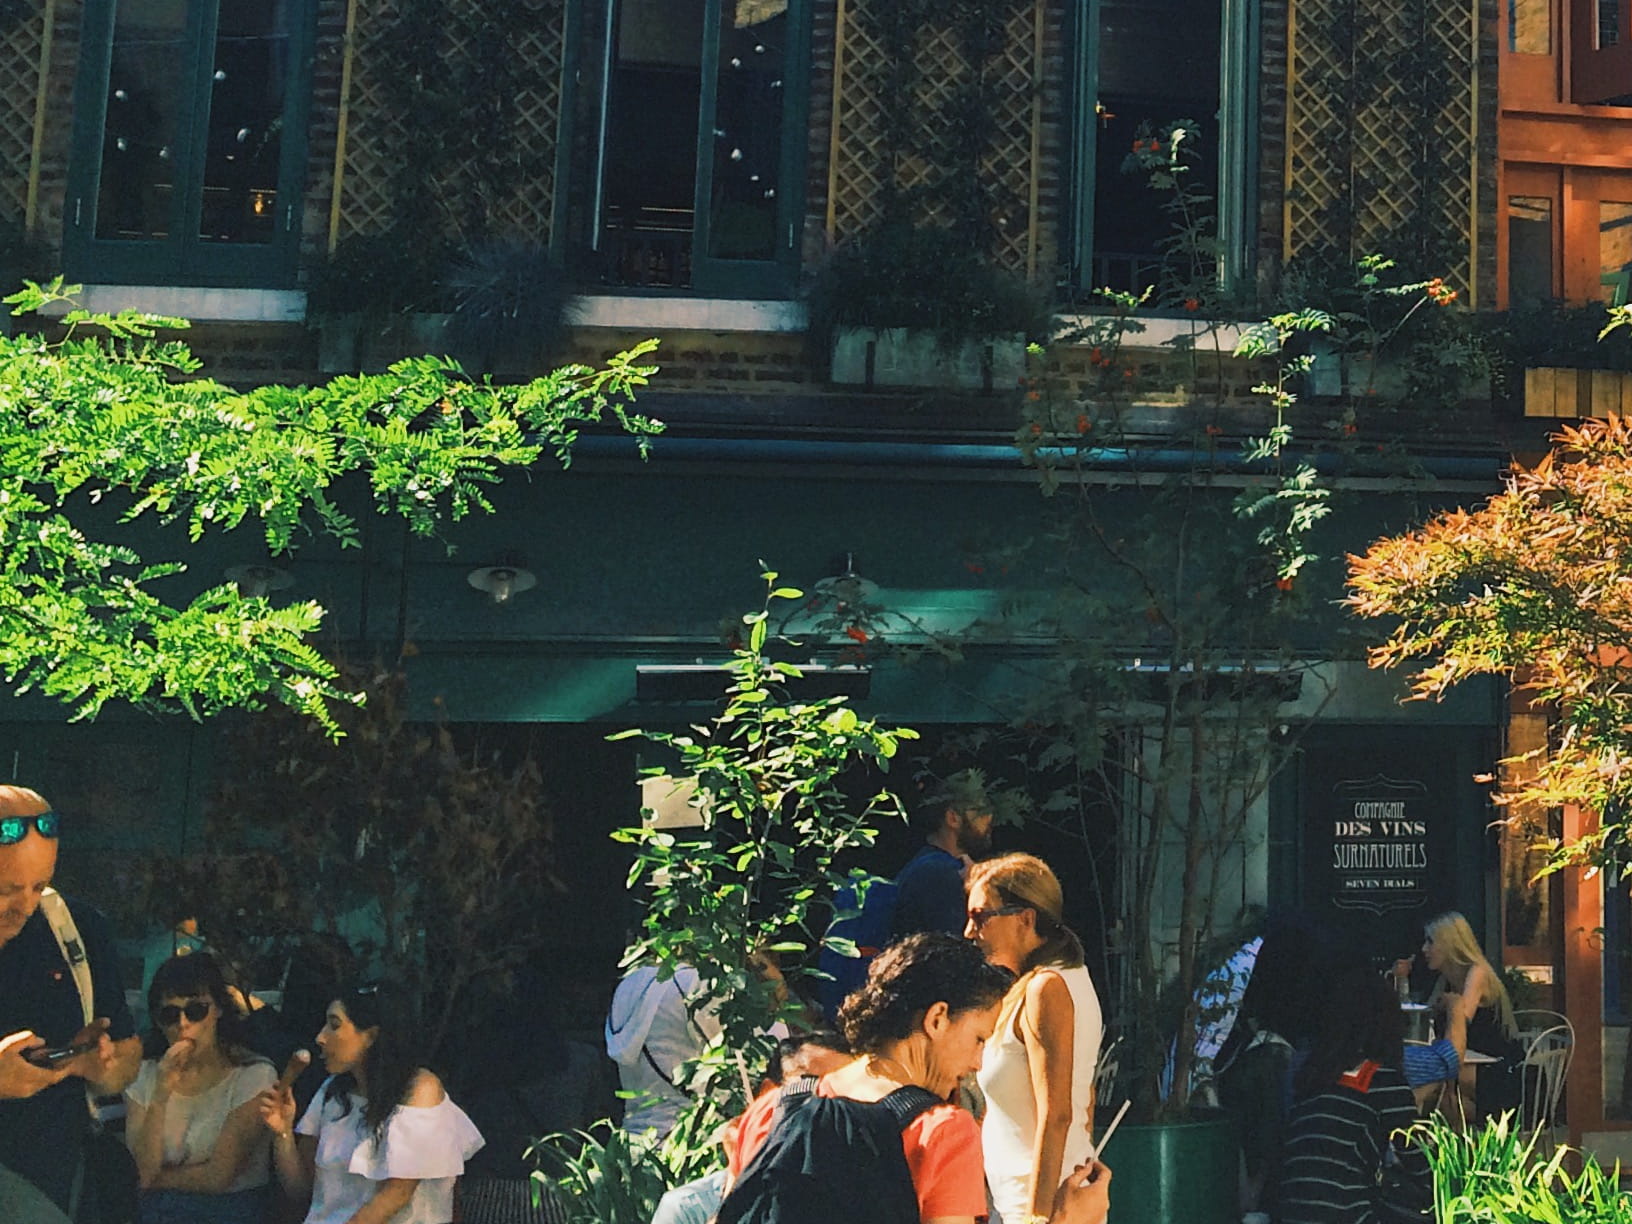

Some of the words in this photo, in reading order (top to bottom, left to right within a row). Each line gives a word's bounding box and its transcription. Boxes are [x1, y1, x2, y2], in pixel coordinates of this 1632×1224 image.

[1354, 802, 1405, 819] COMPAGNIE
[1335, 821, 1372, 836] DES
[1380, 821, 1426, 836] VINS
[1333, 843, 1428, 869] SURNATURELS
[1345, 879, 1380, 889] SEVEN
[1383, 879, 1415, 889] DIALS
